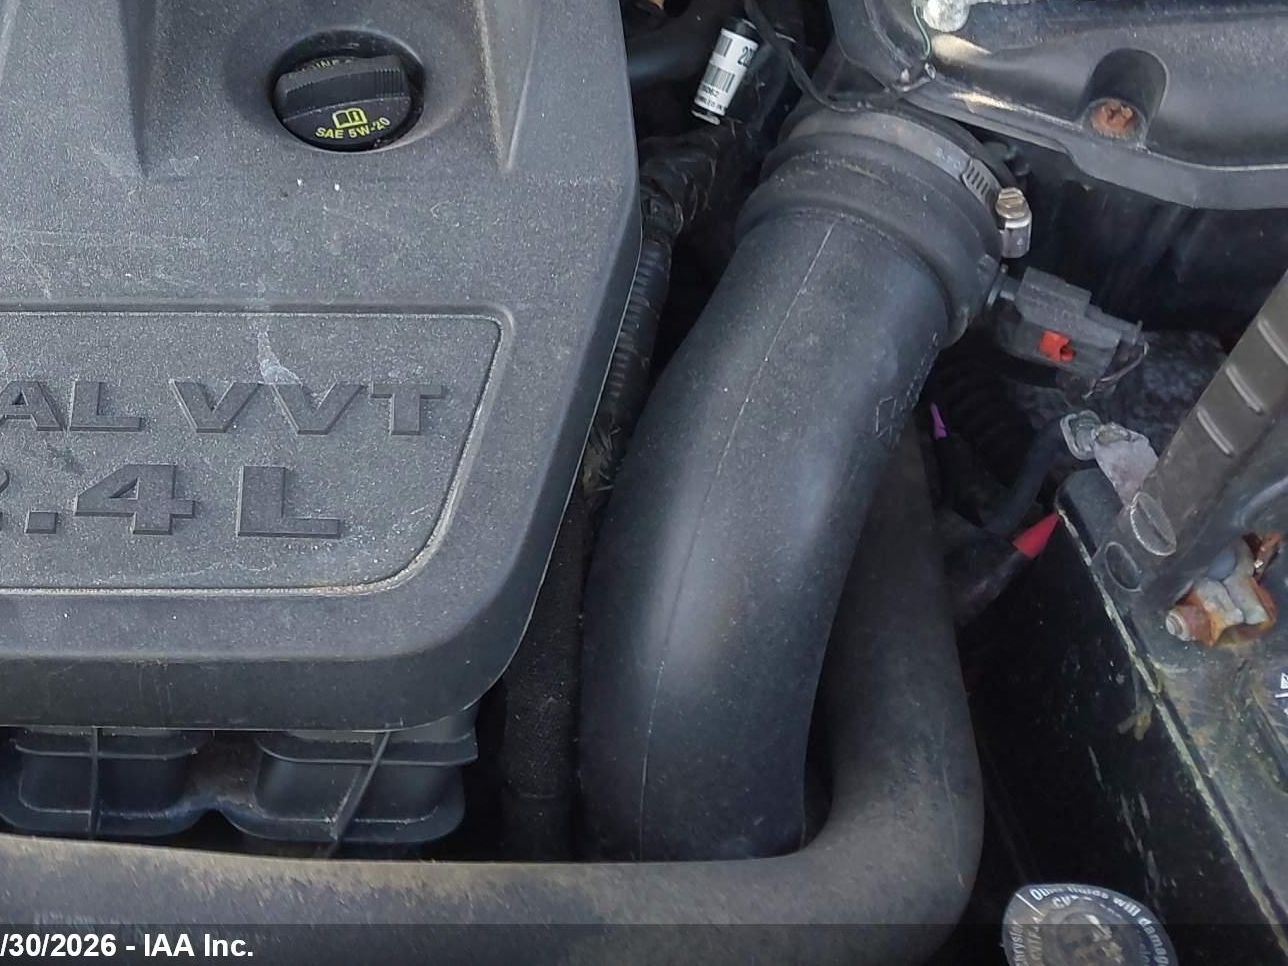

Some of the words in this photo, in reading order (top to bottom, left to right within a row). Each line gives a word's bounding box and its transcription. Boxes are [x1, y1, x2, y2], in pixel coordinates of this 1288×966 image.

[315, 127, 344, 139] SAE
[348, 117, 391, 139] 5W-20
[167, 379, 446, 435] VVT
[235, 464, 344, 539] L
[1113, 897, 1142, 917] will
[1137, 917, 1170, 966] damag
